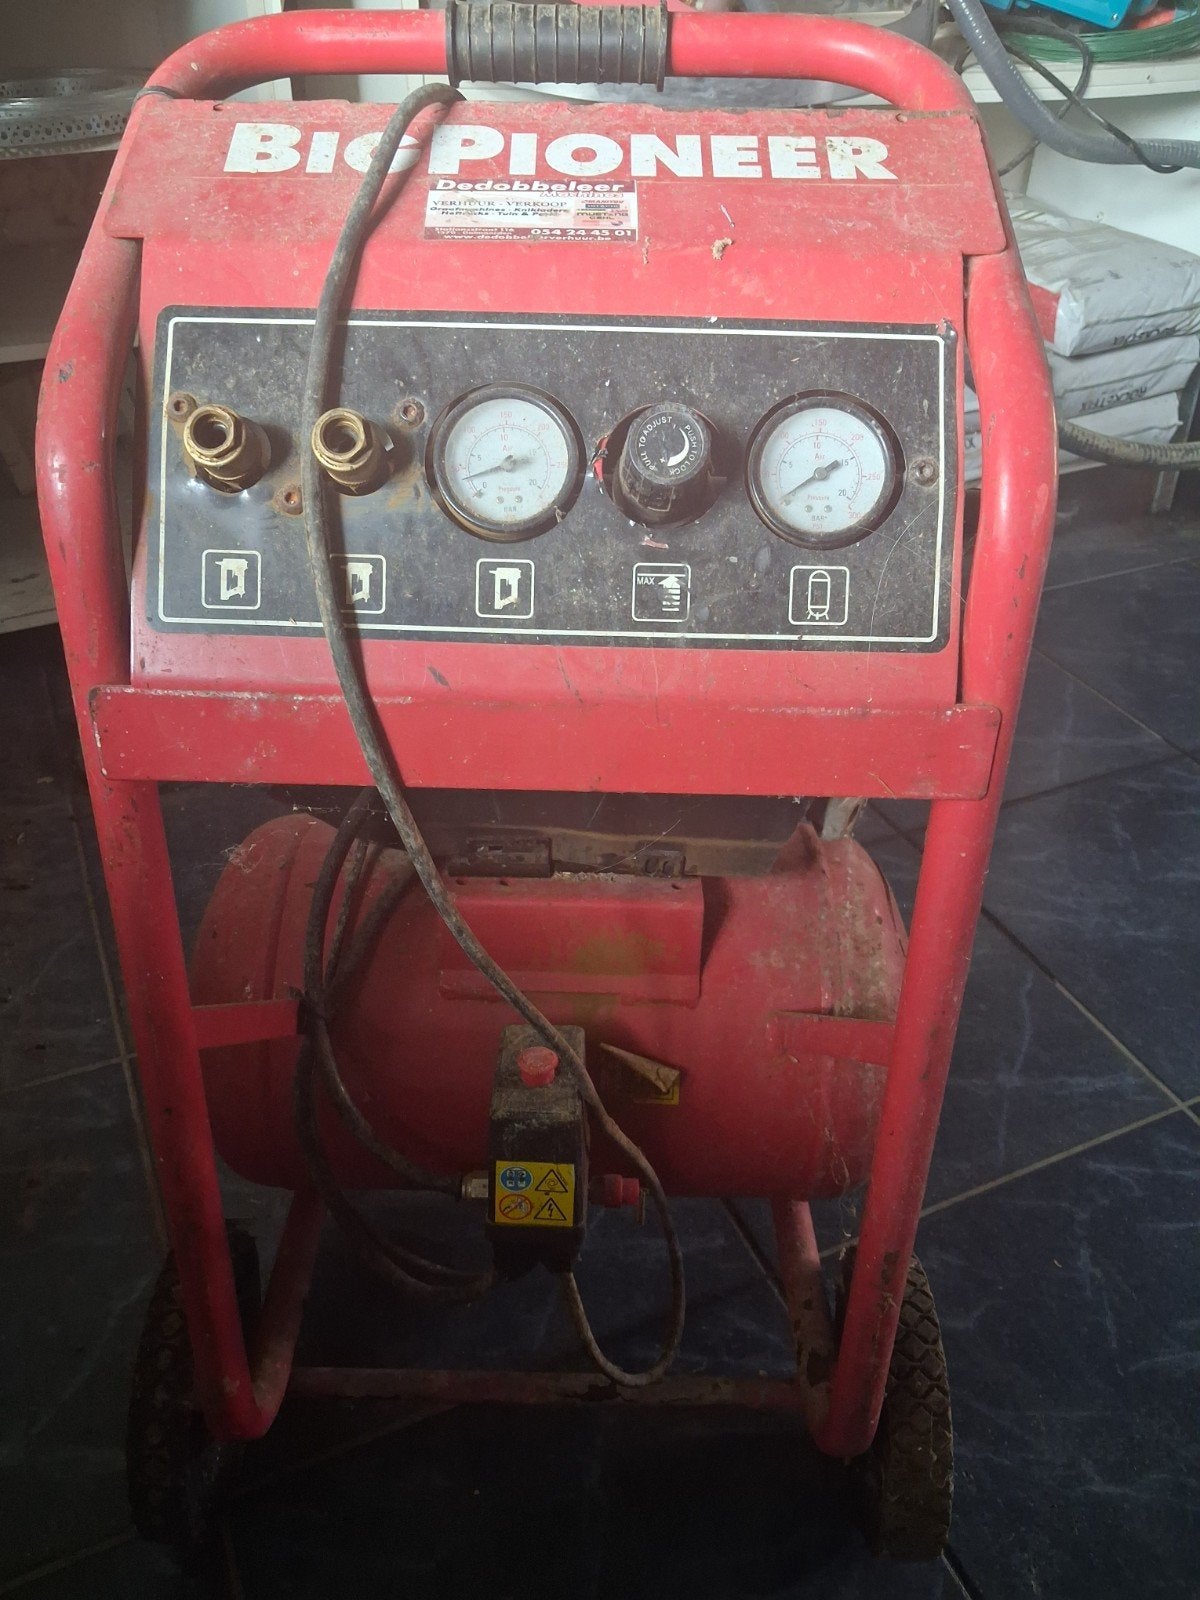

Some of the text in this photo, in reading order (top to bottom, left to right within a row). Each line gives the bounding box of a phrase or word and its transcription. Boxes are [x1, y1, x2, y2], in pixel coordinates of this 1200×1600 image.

[428, 125, 898, 180] PIONEER
[436, 180, 624, 192] Dedobbeleer
[639, 416, 672, 471] PULL TO ADJUST
[670, 424, 697, 475] PUSH TO LOCK
[838, 489, 847, 497] 20
[637, 577, 655, 585] MAX
